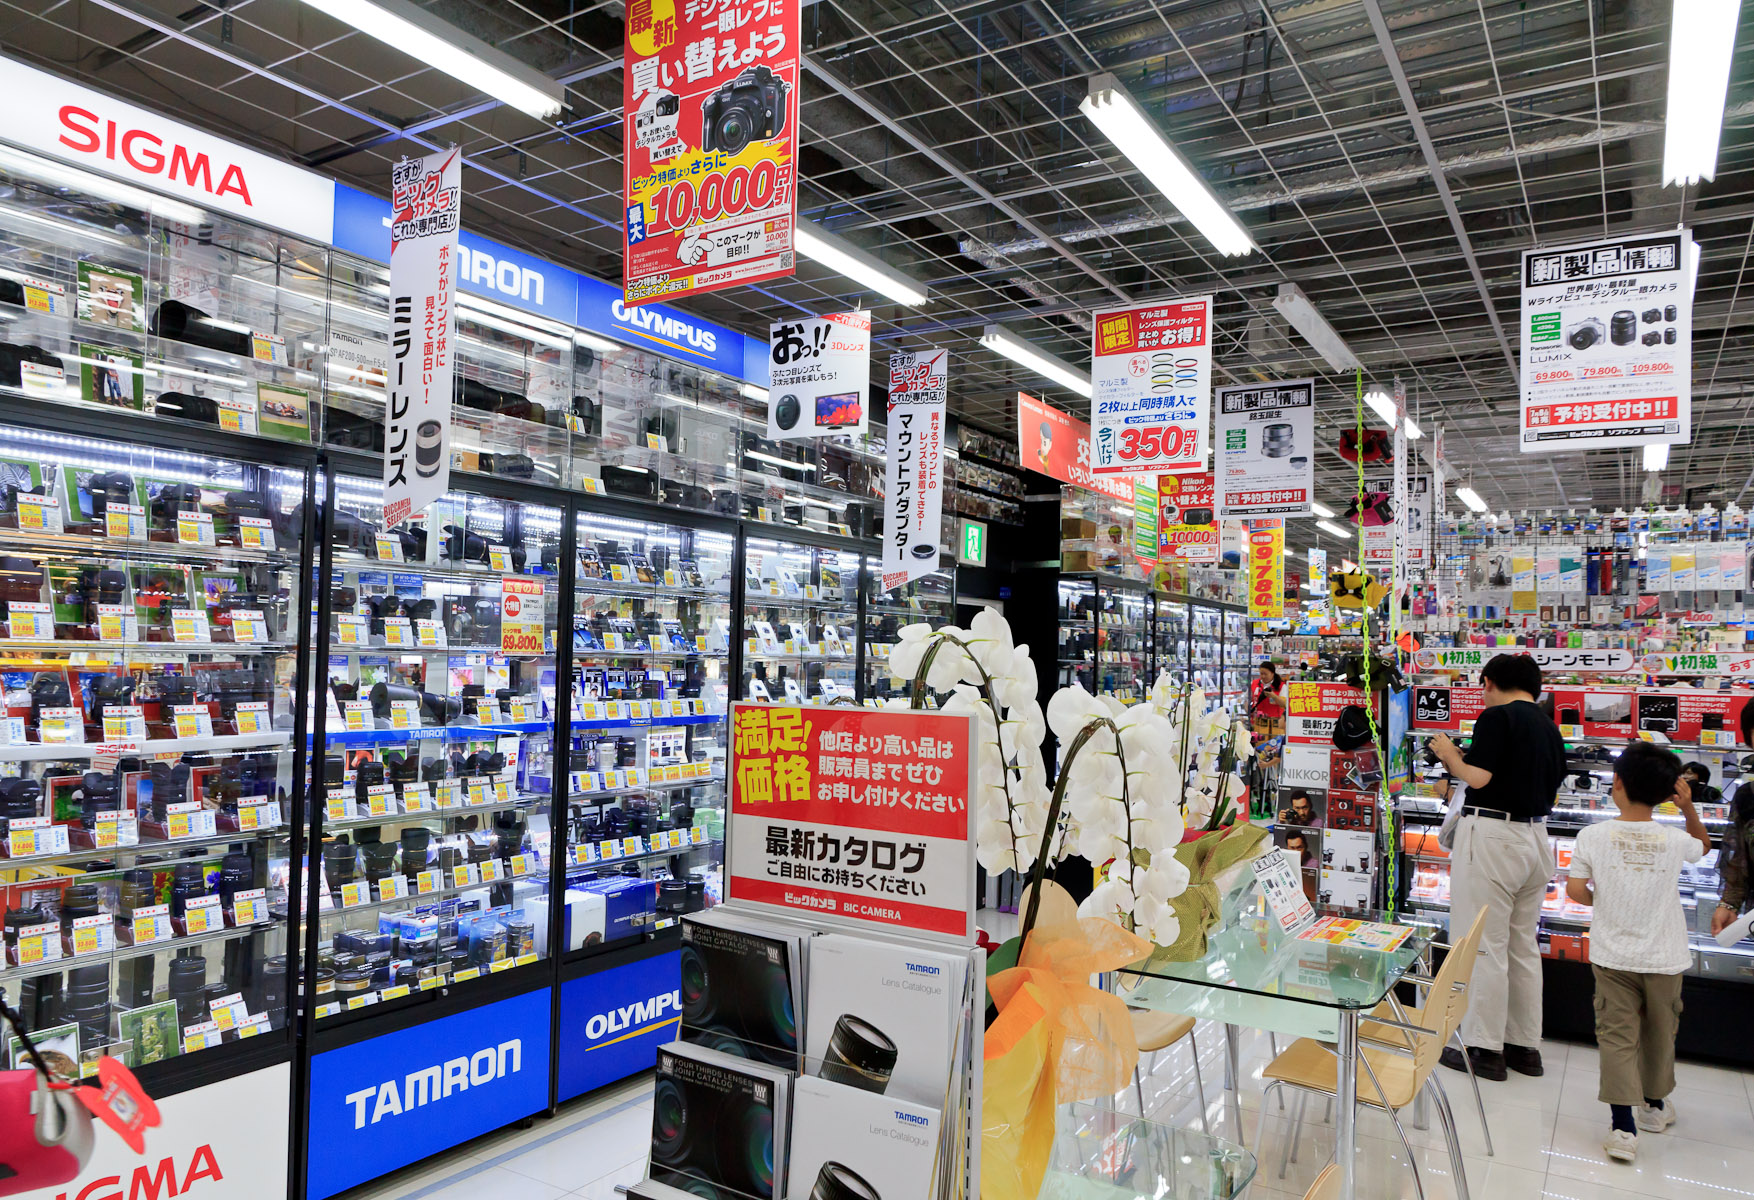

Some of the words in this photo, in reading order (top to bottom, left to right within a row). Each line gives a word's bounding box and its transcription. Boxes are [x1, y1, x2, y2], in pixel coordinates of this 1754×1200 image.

[701, 1, 783, 34] 一眼レフに
[632, 25, 786, 101] 買い替えよう
[58, 106, 253, 206] SIGMA
[653, 144, 683, 160] 買い替えで
[393, 162, 422, 185] さすが
[393, 172, 441, 211] ビック
[413, 189, 458, 218] カメラ!!
[393, 213, 457, 239] これが専門店!!
[628, 206, 644, 244] 最大
[716, 229, 761, 248] このマークが
[726, 245, 750, 259] 目印!!
[1533, 246, 1674, 282] 新製品情報
[627, 273, 670, 290] ビック特価より
[697, 271, 733, 285] ビックカメラ
[436, 245, 450, 367] ボケがリング状に
[1139, 309, 1168, 320] マルミ製
[611, 299, 717, 352] OLYMPUS
[1102, 318, 1129, 336] 期間
[1138, 317, 1201, 330] レンズ保護フィルター
[330, 332, 363, 346] TAMRON
[772, 323, 832, 365] おっ!!
[1103, 332, 1131, 350] 限定
[1137, 339, 1159, 349] 買いが
[1138, 330, 1159, 340] まとめ
[1160, 326, 1202, 346] お得!
[422, 296, 435, 405] 見えて面白い!
[831, 341, 864, 352] 3Dレンズ
[890, 354, 915, 369] さすが
[1530, 353, 1572, 363] LUMIX
[772, 363, 822, 379] ふたつ目レンズで
[772, 371, 838, 387] 3次元写真を楽しもう!
[890, 363, 931, 386] ビック
[1133, 366, 1145, 375] 7色
[388, 296, 411, 488] ミラーレンズ
[909, 375, 946, 391] カメラ!!
[1098, 378, 1128, 388] マルミ製
[890, 391, 946, 405] これが専門店!!
[1098, 394, 1197, 414] 2枚以上同時購入で
[1225, 389, 1308, 413] 新製品情報
[1554, 400, 1669, 423] 予約受付中!!
[928, 412, 940, 490] 異なるマウントの
[1098, 427, 1113, 465] 今だけ
[895, 413, 914, 561] マウントアダプター
[916, 432, 928, 532] レンズも装着できる!
[1182, 478, 1205, 486] Nikon
[1241, 491, 1302, 504] 予約受付中!!
[386, 507, 412, 528] SELECTION
[505, 582, 541, 594] 広告の品
[1449, 650, 1482, 664] 初級
[1537, 652, 1621, 666] シーンモード
[1680, 655, 1718, 669] 初級
[1288, 683, 1321, 698] 満足!
[1289, 697, 1321, 713] 価格
[1418, 708, 1448, 720] シーン
[409, 729, 447, 739] TAMRON
[734, 707, 813, 756] 満足!
[96, 743, 137, 754] SIGMA
[819, 730, 954, 760] 他店より高い品は
[736, 754, 811, 804] 価格
[818, 756, 943, 786] 販売員までぜひ
[1283, 767, 1329, 782] NIKKOR
[817, 782, 965, 814] お申し付けください
[765, 825, 927, 874] 最新カタログ
[767, 860, 927, 897] ご自由にお持ちください
[784, 892, 837, 910] ビックカメラ
[843, 902, 859, 913] BIC
[860, 904, 902, 921] CAMERA
[693, 925, 711, 935] FOUR
[712, 929, 738, 942] THIRDS
[739, 936, 766, 950] LENSES
[694, 933, 713, 944] JOINT
[714, 938, 749, 951] CATALOG
[905, 962, 940, 976] TAMRON
[881, 977, 901, 989] Lens
[901, 980, 942, 996] Catalogue
[674, 1058, 694, 1069] FOUR
[695, 1064, 722, 1078] THIRDS
[723, 1072, 753, 1088] LENSES
[674, 1067, 695, 1078] JOINT
[696, 1073, 733, 1089] CATALOG
[345, 1038, 522, 1130] TAMRON
[894, 1111, 929, 1127] TAMRON
[869, 1125, 889, 1138] Lens
[890, 1130, 930, 1148] Catalogue
